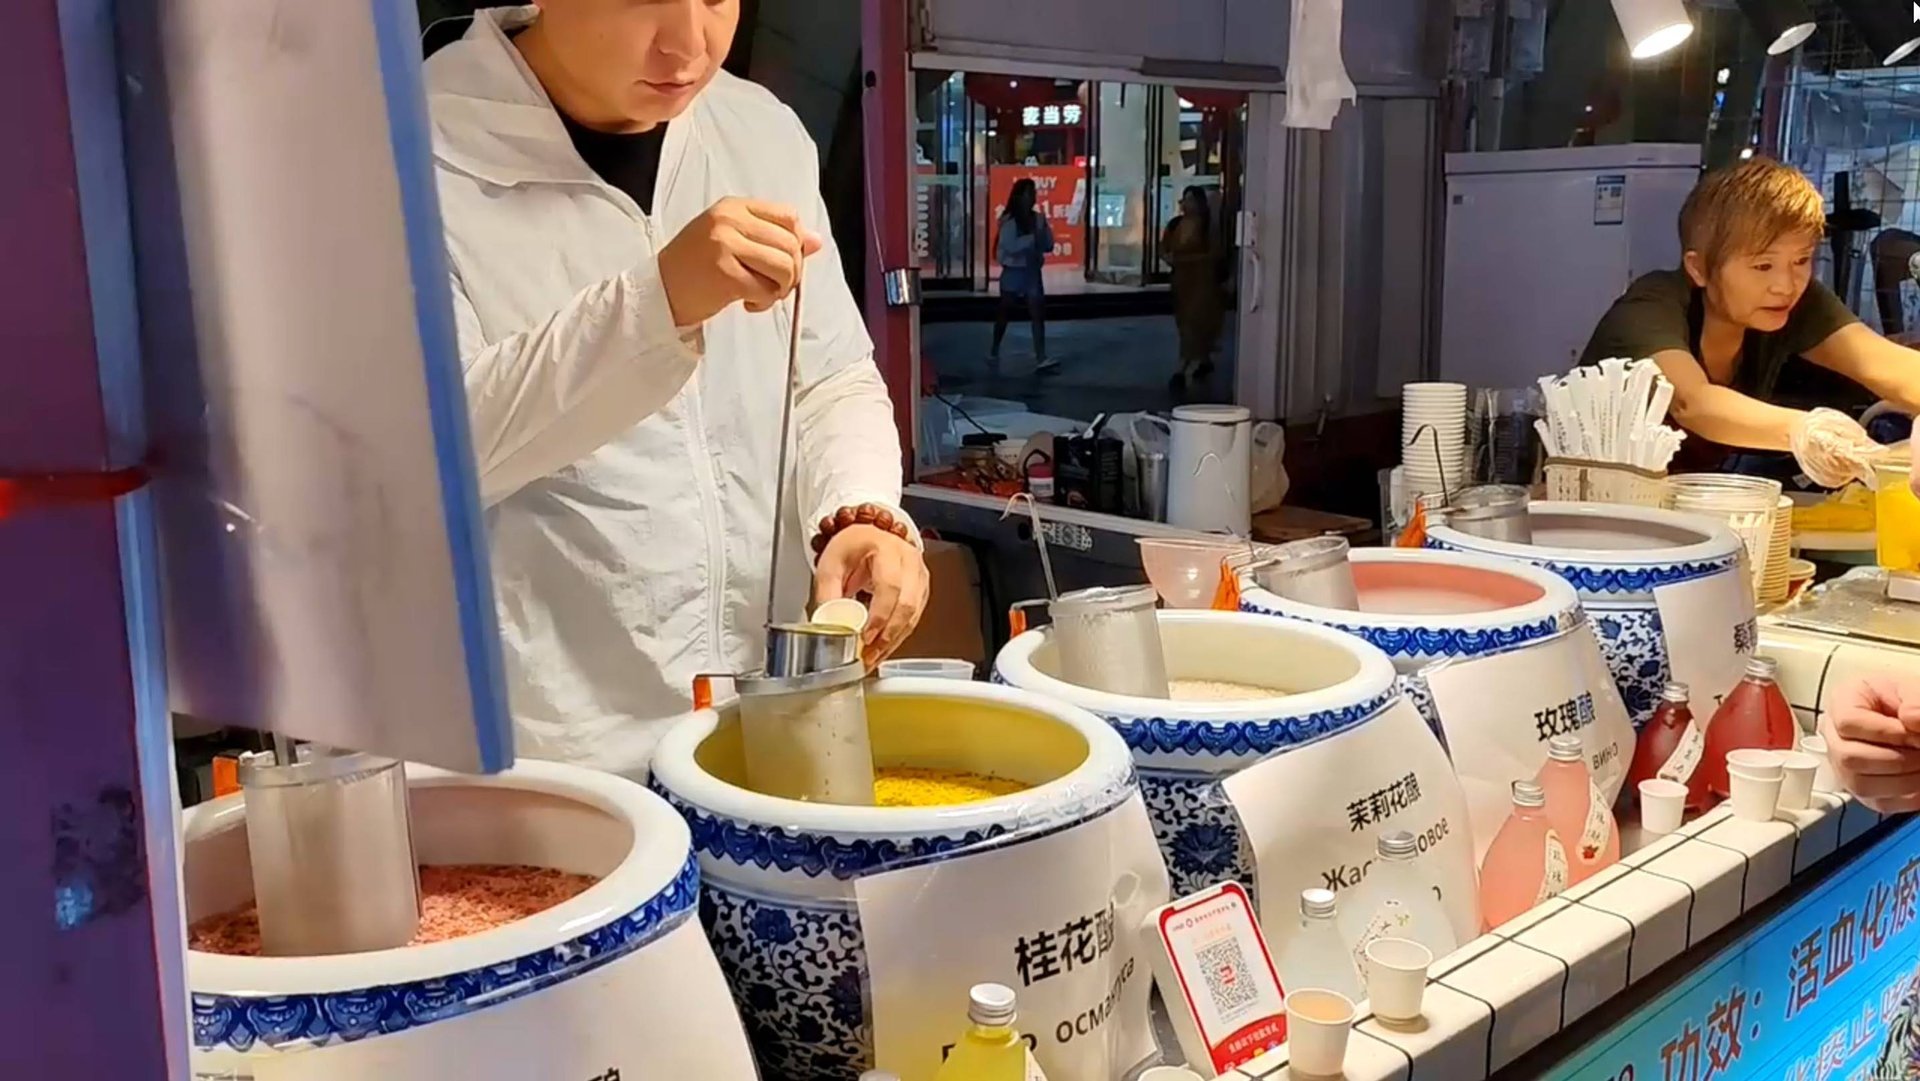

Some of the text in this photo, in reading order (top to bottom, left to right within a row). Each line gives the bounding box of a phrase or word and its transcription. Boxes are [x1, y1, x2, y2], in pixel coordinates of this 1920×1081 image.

[1022, 104, 1082, 126] 麦当劳
[1533, 690, 1596, 743] 玫瑰酿
[1346, 770, 1423, 833] 茉莉花酿
